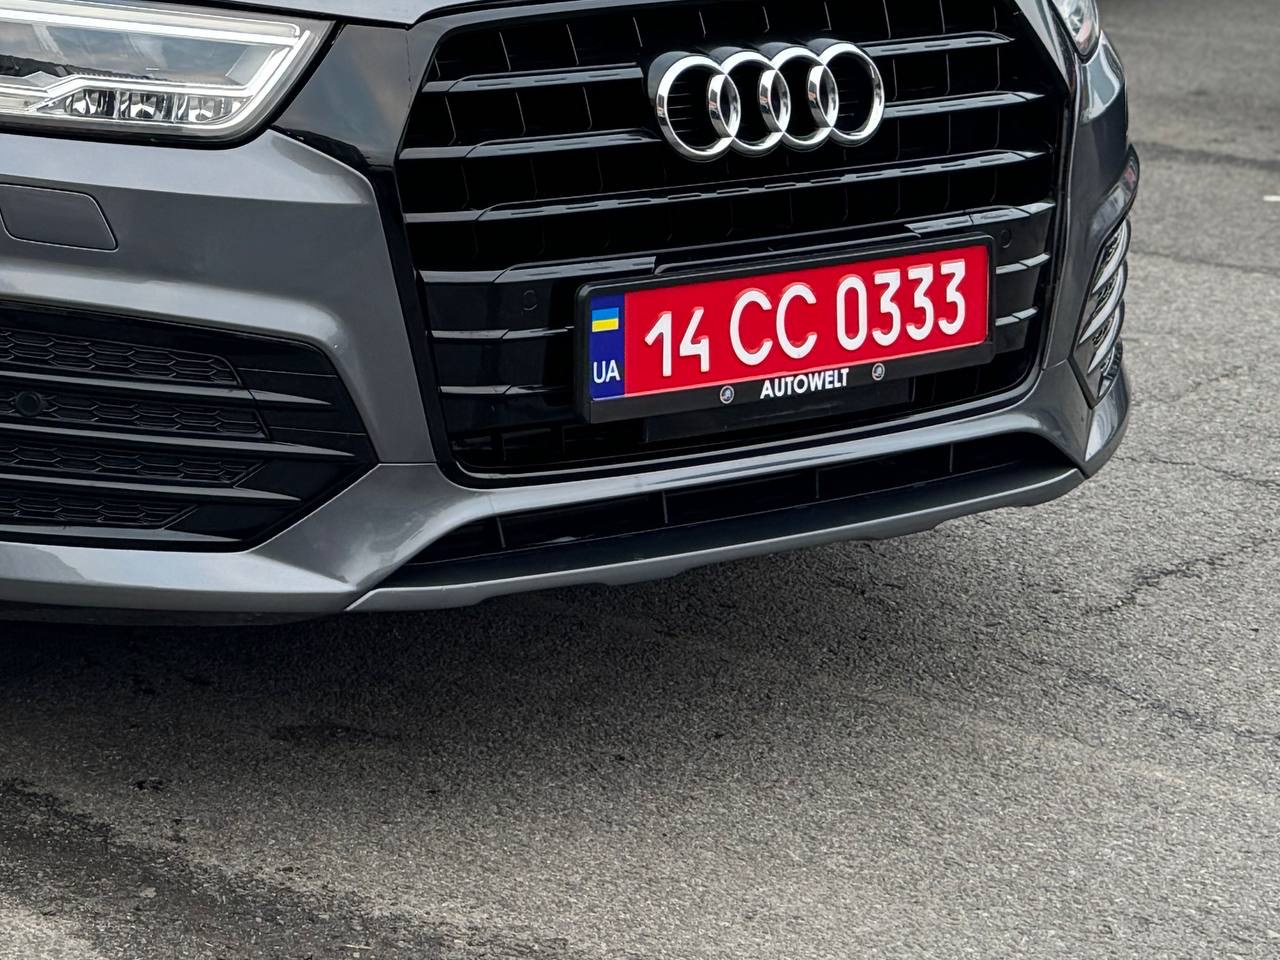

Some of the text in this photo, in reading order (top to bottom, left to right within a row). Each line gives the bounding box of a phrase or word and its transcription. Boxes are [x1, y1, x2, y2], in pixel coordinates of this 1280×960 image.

[643, 258, 966, 377] 14 CC 0333
[593, 359, 621, 384] UA
[759, 367, 850, 400] AUTOWELT
